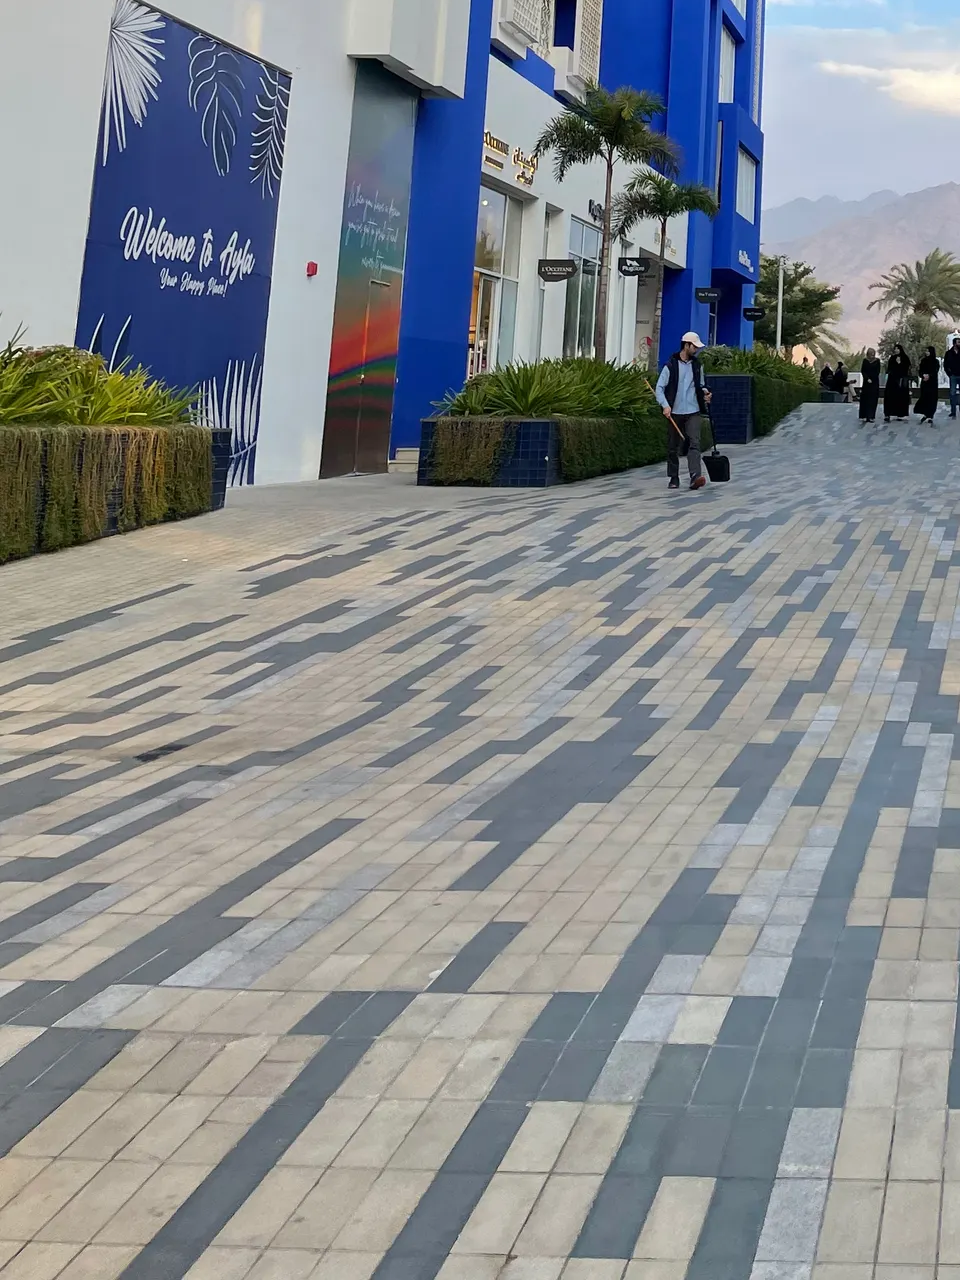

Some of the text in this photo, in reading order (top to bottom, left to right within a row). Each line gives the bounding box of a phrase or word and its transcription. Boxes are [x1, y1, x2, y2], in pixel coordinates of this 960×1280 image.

[120, 206, 256, 284] Welcome to Ayla
[160, 268, 228, 297] Your Happy Place!
